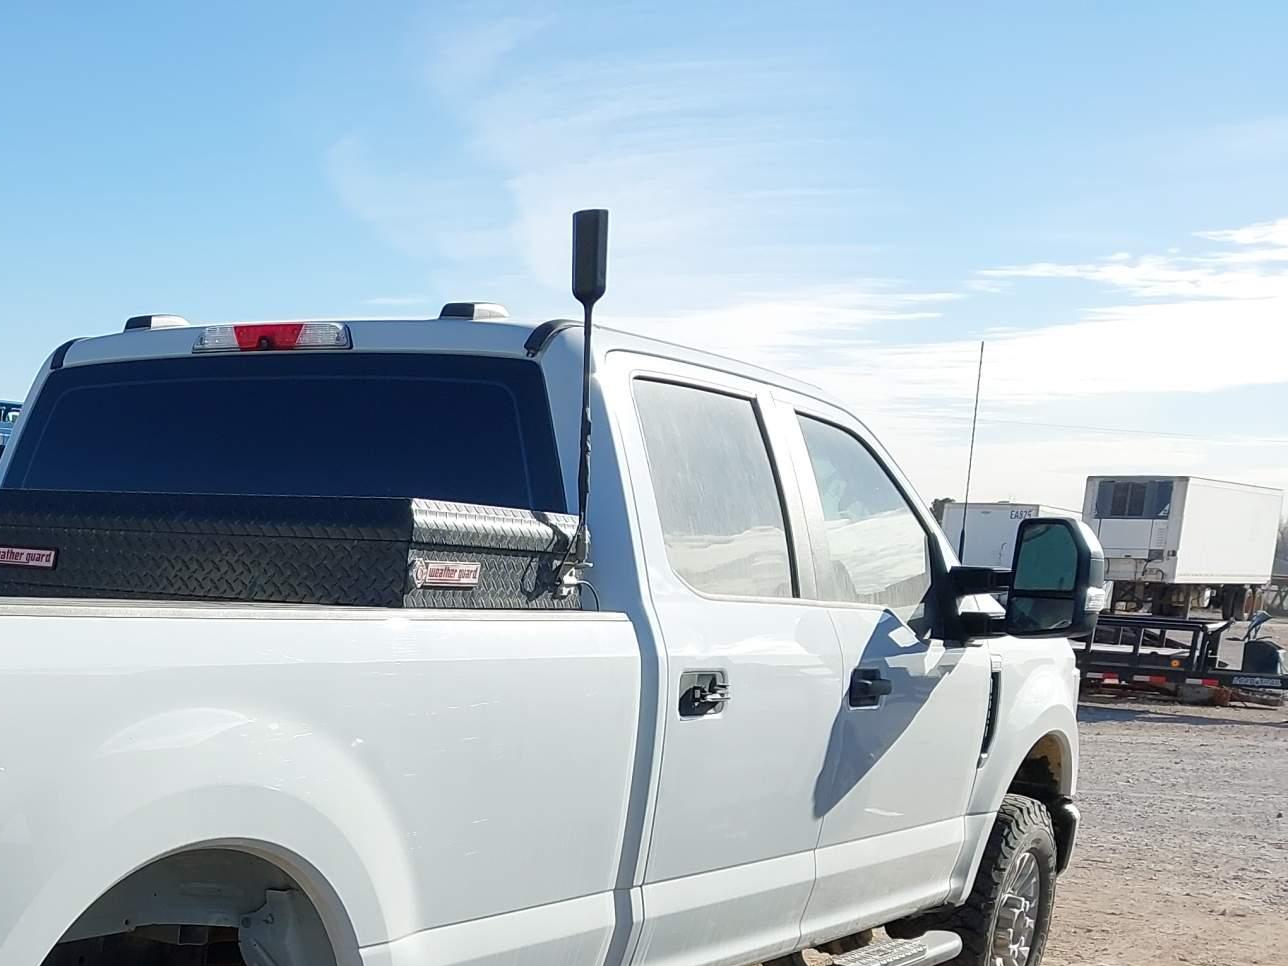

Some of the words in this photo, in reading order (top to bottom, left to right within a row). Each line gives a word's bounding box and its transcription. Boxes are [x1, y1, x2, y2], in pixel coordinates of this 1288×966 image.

[25, 551, 52, 563] guard
[428, 566, 458, 578] weather
[458, 567, 479, 579] guard
